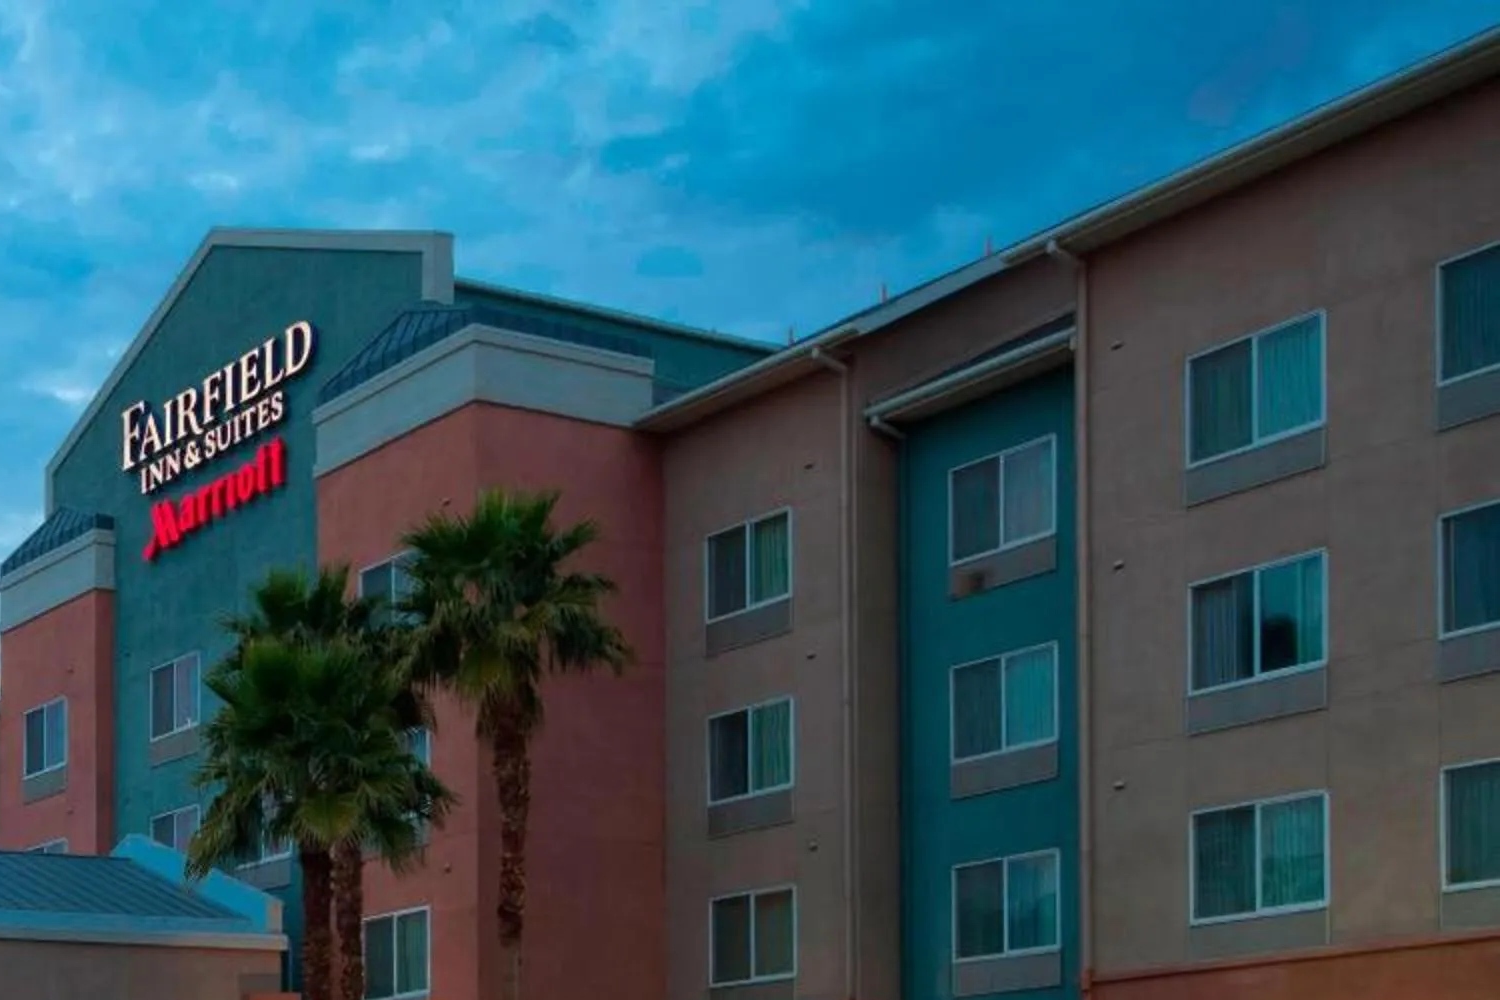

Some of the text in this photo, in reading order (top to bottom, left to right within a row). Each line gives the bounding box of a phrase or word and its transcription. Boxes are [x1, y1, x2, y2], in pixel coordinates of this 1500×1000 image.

[121, 320, 313, 471] FAIRFIELD
[140, 391, 285, 494] INN & SUITES
[142, 435, 286, 560] Marriott
